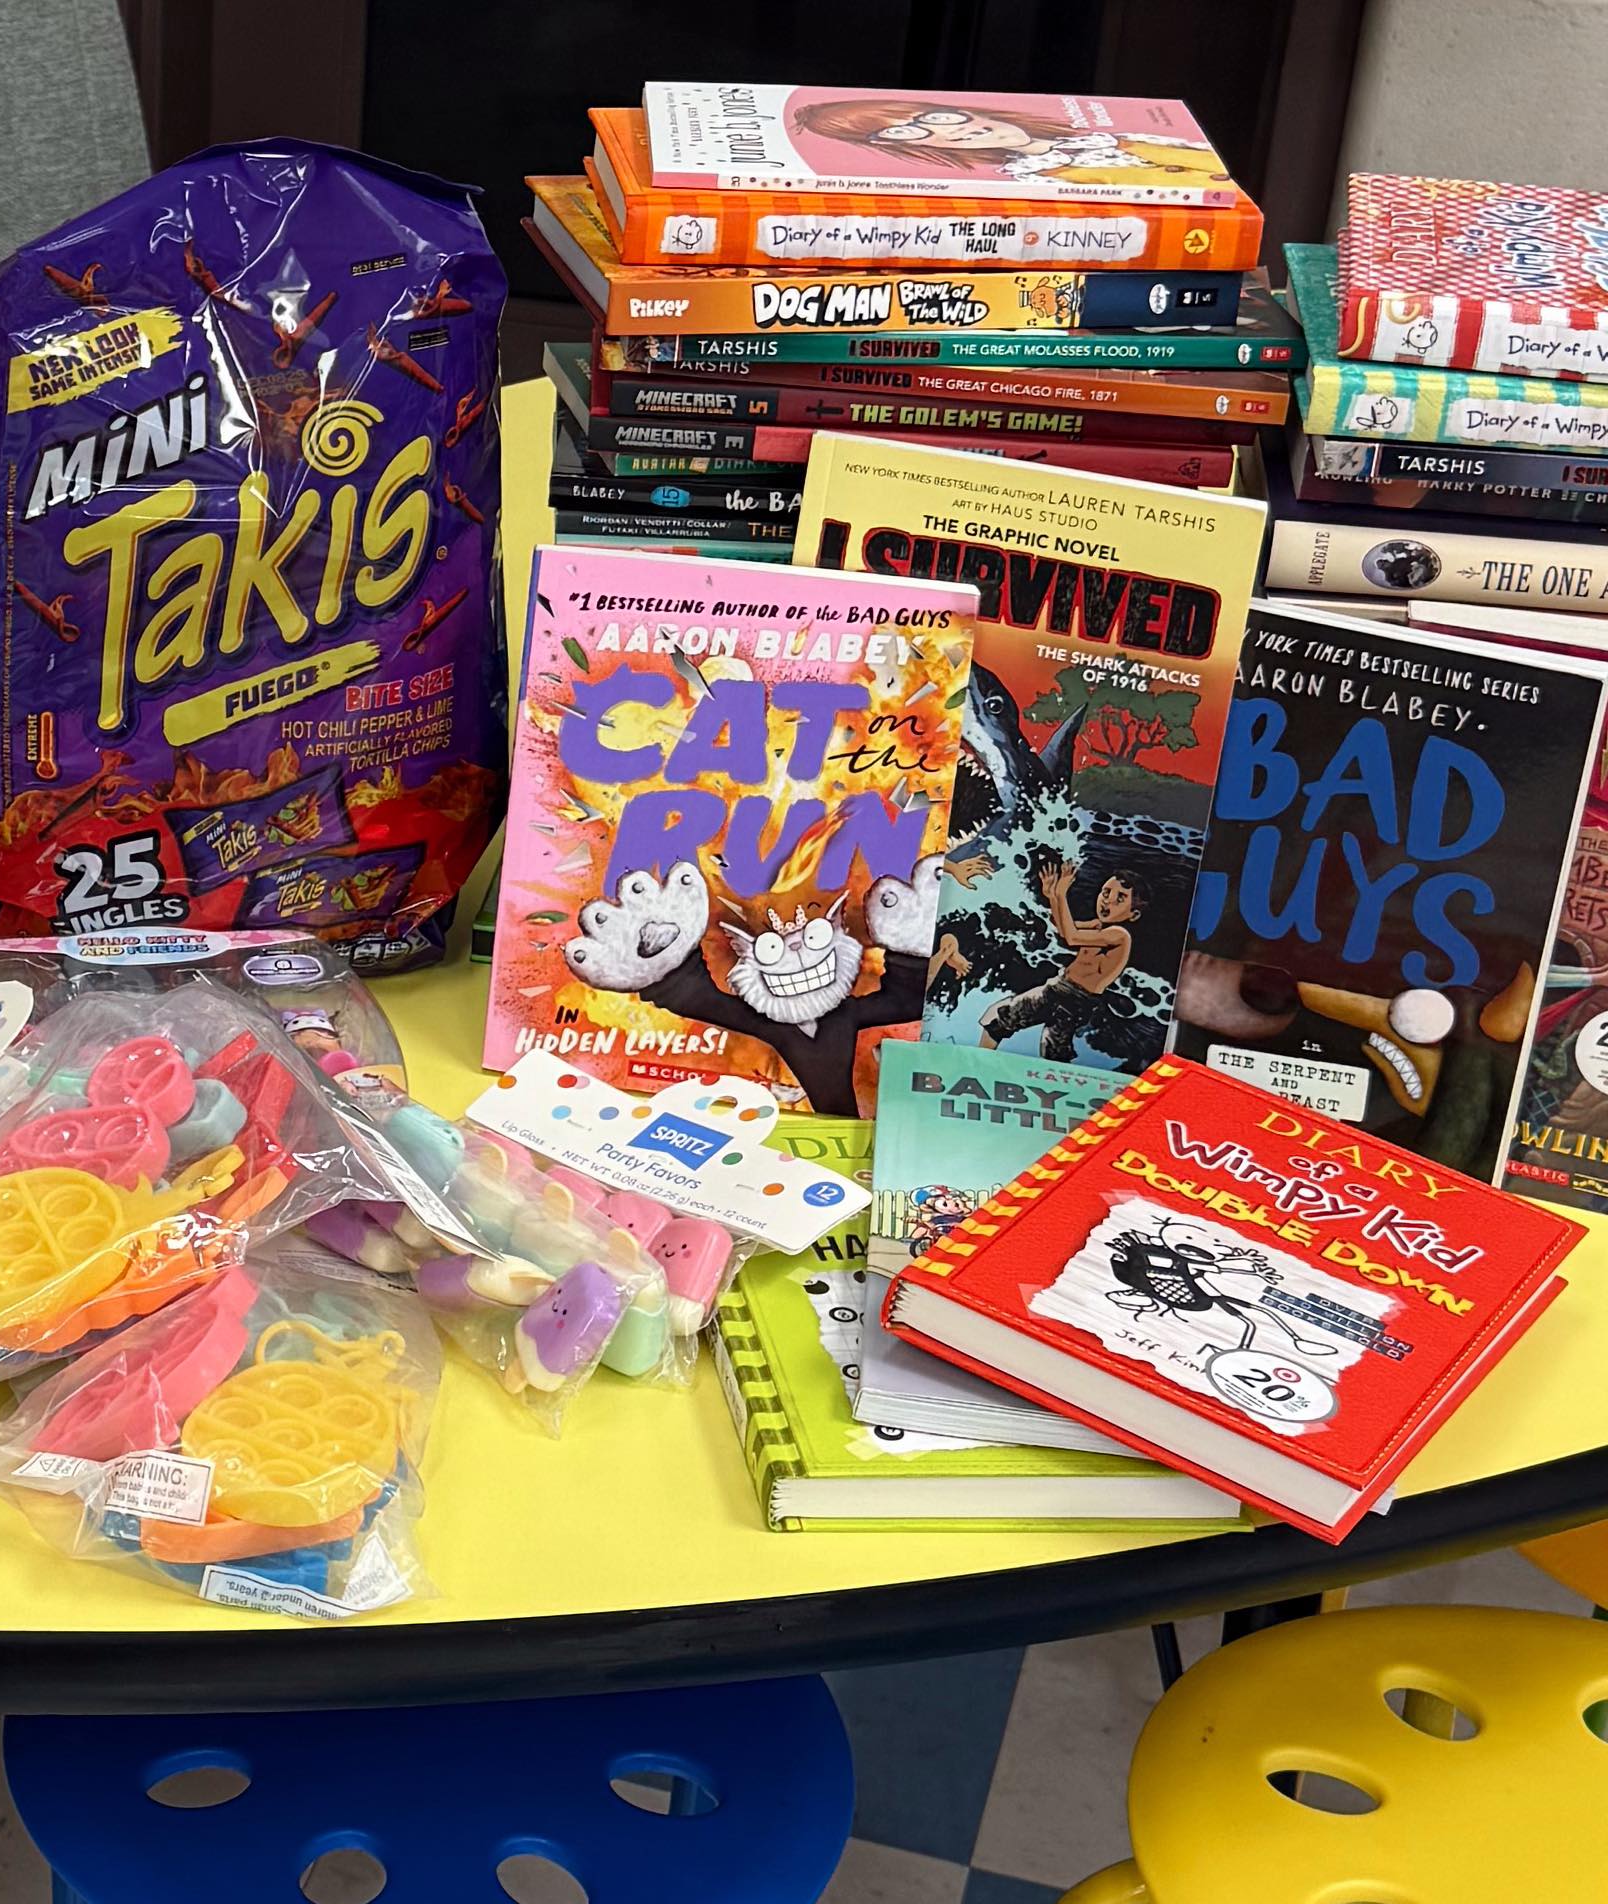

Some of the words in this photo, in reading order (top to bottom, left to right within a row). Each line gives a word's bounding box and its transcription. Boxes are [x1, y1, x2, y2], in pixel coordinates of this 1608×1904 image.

[1477, 196, 1556, 234] Kid
[771, 225, 822, 247] Diary
[825, 228, 842, 243] of
[843, 233, 852, 242] a
[855, 227, 912, 249] Wimpy
[915, 221, 942, 245] Kid
[949, 221, 978, 238] THE
[980, 221, 1017, 238] LONG
[964, 237, 999, 255] HAUL
[1047, 230, 1133, 250] KINNEY
[1490, 232, 1580, 292] Wimpy
[751, 282, 822, 327] DOG
[823, 283, 892, 324] MAN
[898, 280, 951, 305] BRAWL
[696, 339, 779, 357] TARSHIS
[859, 339, 942, 359] SURVIVED
[952, 343, 977, 356] THE
[979, 343, 1022, 356] GREAT
[1024, 343, 1091, 358] MOLASSES
[1093, 344, 1142, 359] FLOOD,
[1145, 345, 1175, 358] 1919
[1507, 334, 1561, 359] Diary
[1565, 344, 1581, 356] of
[29, 373, 78, 402] SAME
[831, 367, 912, 388] SURVIVED
[917, 376, 943, 389] THE
[945, 378, 988, 393] GREAT
[990, 382, 1052, 398] CHICAGO
[1089, 389, 1118, 402] 1871
[634, 389, 739, 410] MINECRAFT
[849, 403, 895, 424] THE
[898, 404, 1003, 430] GOLEM'S
[1007, 409, 1084, 434] GAME!
[1466, 410, 1520, 431] Diary
[1523, 416, 1539, 429] of
[614, 425, 718, 446] MINECRAFT
[1397, 455, 1486, 476] TARSHIS
[572, 484, 626, 501] BLABEY
[662, 487, 681, 506] 15
[725, 488, 760, 513] the
[844, 462, 871, 477] NEW
[871, 464, 901, 481] YORK
[901, 468, 933, 486] TIMES
[933, 474, 1000, 497] BESTSELLING
[1001, 484, 1045, 503] AUTHOR
[1048, 489, 1126, 518] LAUREN
[1134, 504, 1218, 534] TARSHIS
[1482, 483, 1552, 500] POTTER
[747, 521, 793, 538] THE
[951, 499, 973, 512] ART
[974, 502, 989, 514] BY
[990, 501, 1033, 521] HAUS
[1039, 508, 1099, 532] STUDIO
[923, 514, 959, 535] THE
[964, 520, 1050, 549] GRAPHIC
[1053, 537, 1121, 563] NOVEL
[63, 421, 433, 731] Takis
[1307, 531, 1331, 587] APPLEGATE
[1481, 560, 1534, 594] THE
[1542, 565, 1593, 598] ONE
[863, 526, 1222, 659] SURVIVED
[711, 600, 778, 619] AUTHOR
[786, 605, 808, 620] OF
[816, 604, 842, 622] the
[846, 606, 891, 626] BAD
[893, 609, 953, 630] GUYS
[596, 622, 739, 658] AARON
[753, 632, 926, 668] BLABEY
[1036, 644, 1068, 662] THE
[1070, 648, 1126, 673] SHARK
[1128, 661, 1201, 688] ATTACKS
[1082, 667, 1107, 685] OF
[1109, 672, 1148, 693] 1916
[1254, 629, 1295, 655] YORK
[1304, 640, 1355, 667] TIMES
[1359, 651, 1473, 692] BESTSELLING
[1480, 677, 1541, 705] SERIES
[225, 662, 324, 719] FUEGO
[345, 679, 404, 712] BITE
[408, 662, 455, 701] SIZE
[281, 720, 314, 740] HOT
[318, 718, 356, 739] CHILI
[360, 709, 413, 735] PEPPER
[426, 695, 454, 719] LIME
[558, 664, 873, 785] CAT
[867, 713, 925, 739] on
[26, 712, 39, 762] EXTREME
[305, 734, 390, 758] ARTIFICIALLY
[350, 746, 409, 773] TORTILLA
[412, 733, 451, 756] CHIPS
[826, 739, 942, 775] the
[1216, 696, 1507, 862] BAD
[605, 789, 931, 899] RUN
[56, 836, 162, 915] 25
[555, 1005, 580, 1027] IN
[1302, 1039, 1324, 1053] in
[1218, 1052, 1258, 1075] THE
[1267, 1060, 1357, 1087] SERPENT
[1271, 1076, 1299, 1091] AND
[650, 1125, 716, 1157] SPRITZ
[1255, 1108, 1468, 1202] DIARY
[596, 1142, 643, 1174] Party
[643, 1159, 703, 1191] Favors
[1288, 1154, 1343, 1181] of
[1344, 1183, 1380, 1201] a
[815, 1184, 839, 1200] 12
[1164, 1119, 1369, 1222] Wimpy
[1361, 1204, 1487, 1275] Kid
[1231, 1366, 1296, 1403] 20
